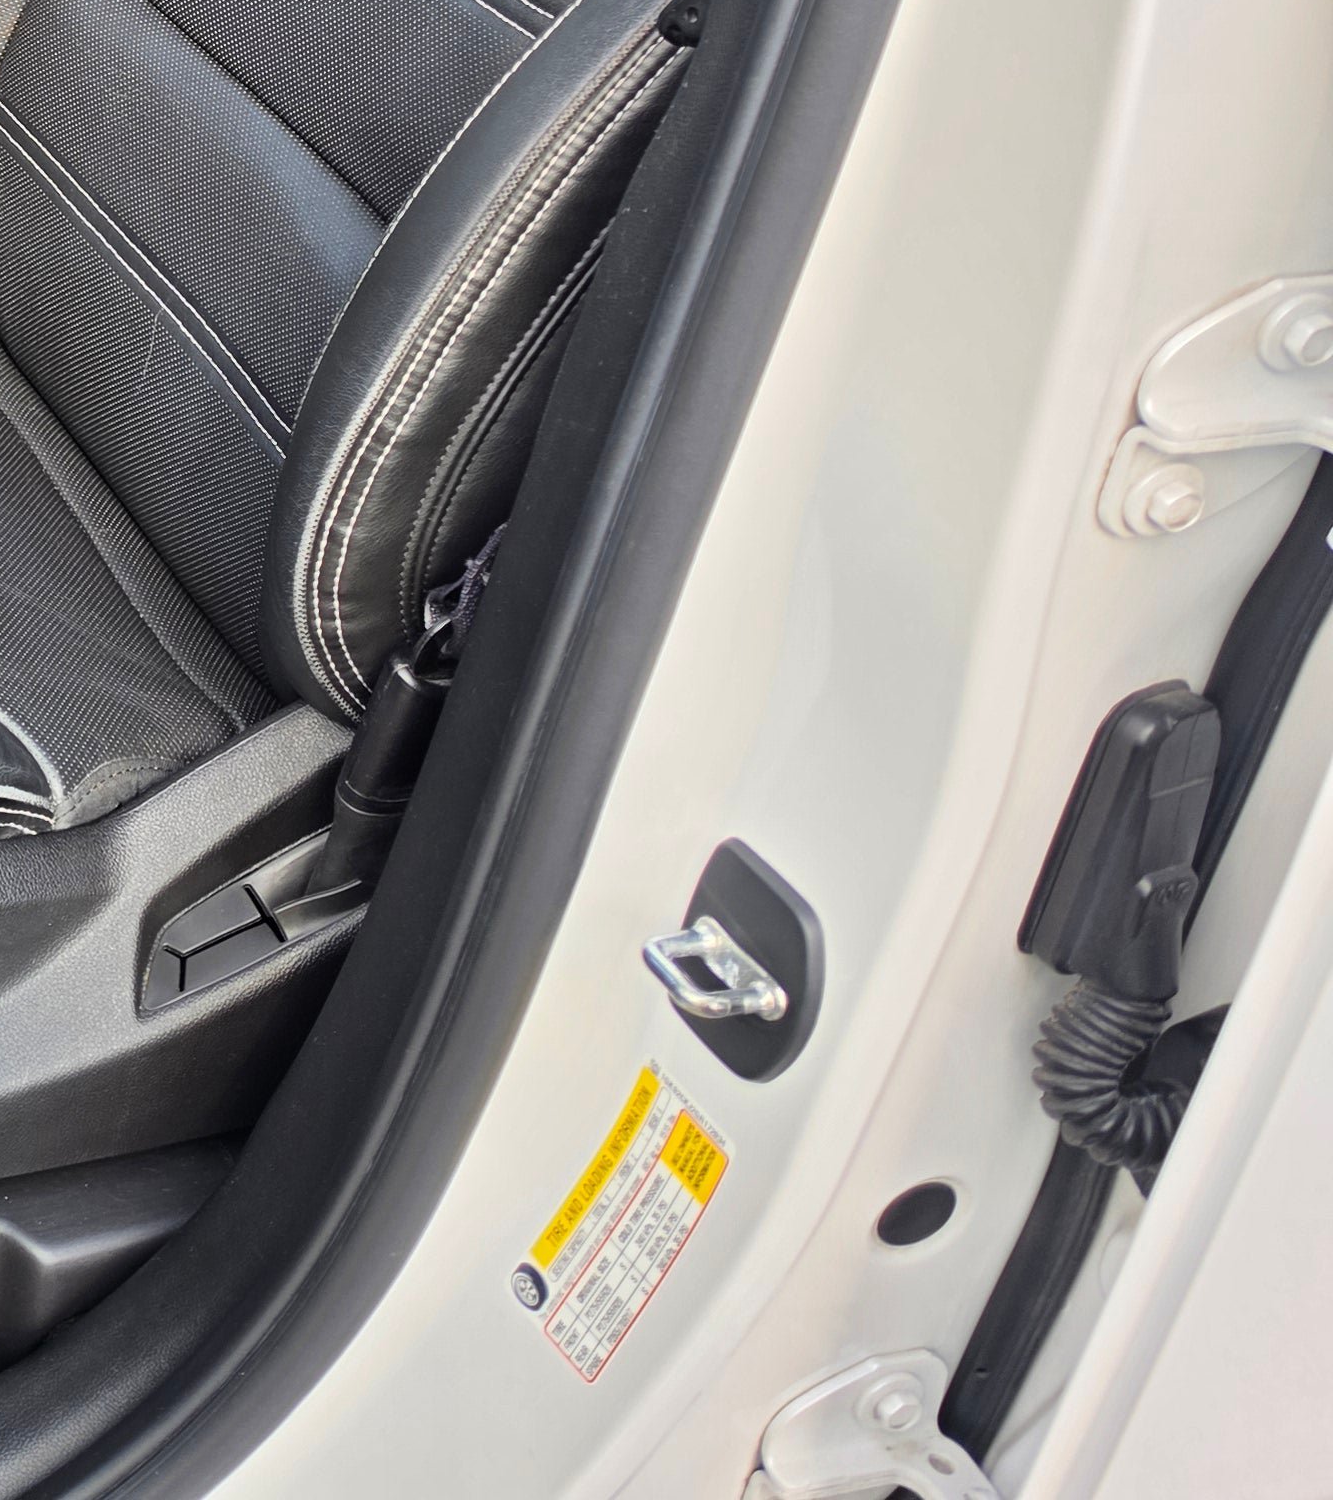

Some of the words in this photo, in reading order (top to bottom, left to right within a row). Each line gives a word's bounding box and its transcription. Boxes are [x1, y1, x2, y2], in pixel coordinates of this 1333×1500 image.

[545, 1218, 568, 1250] TIRE
[562, 1196, 583, 1226] AND
[578, 1150, 613, 1203] LOADING
[606, 1082, 653, 1160] INFORMATION
